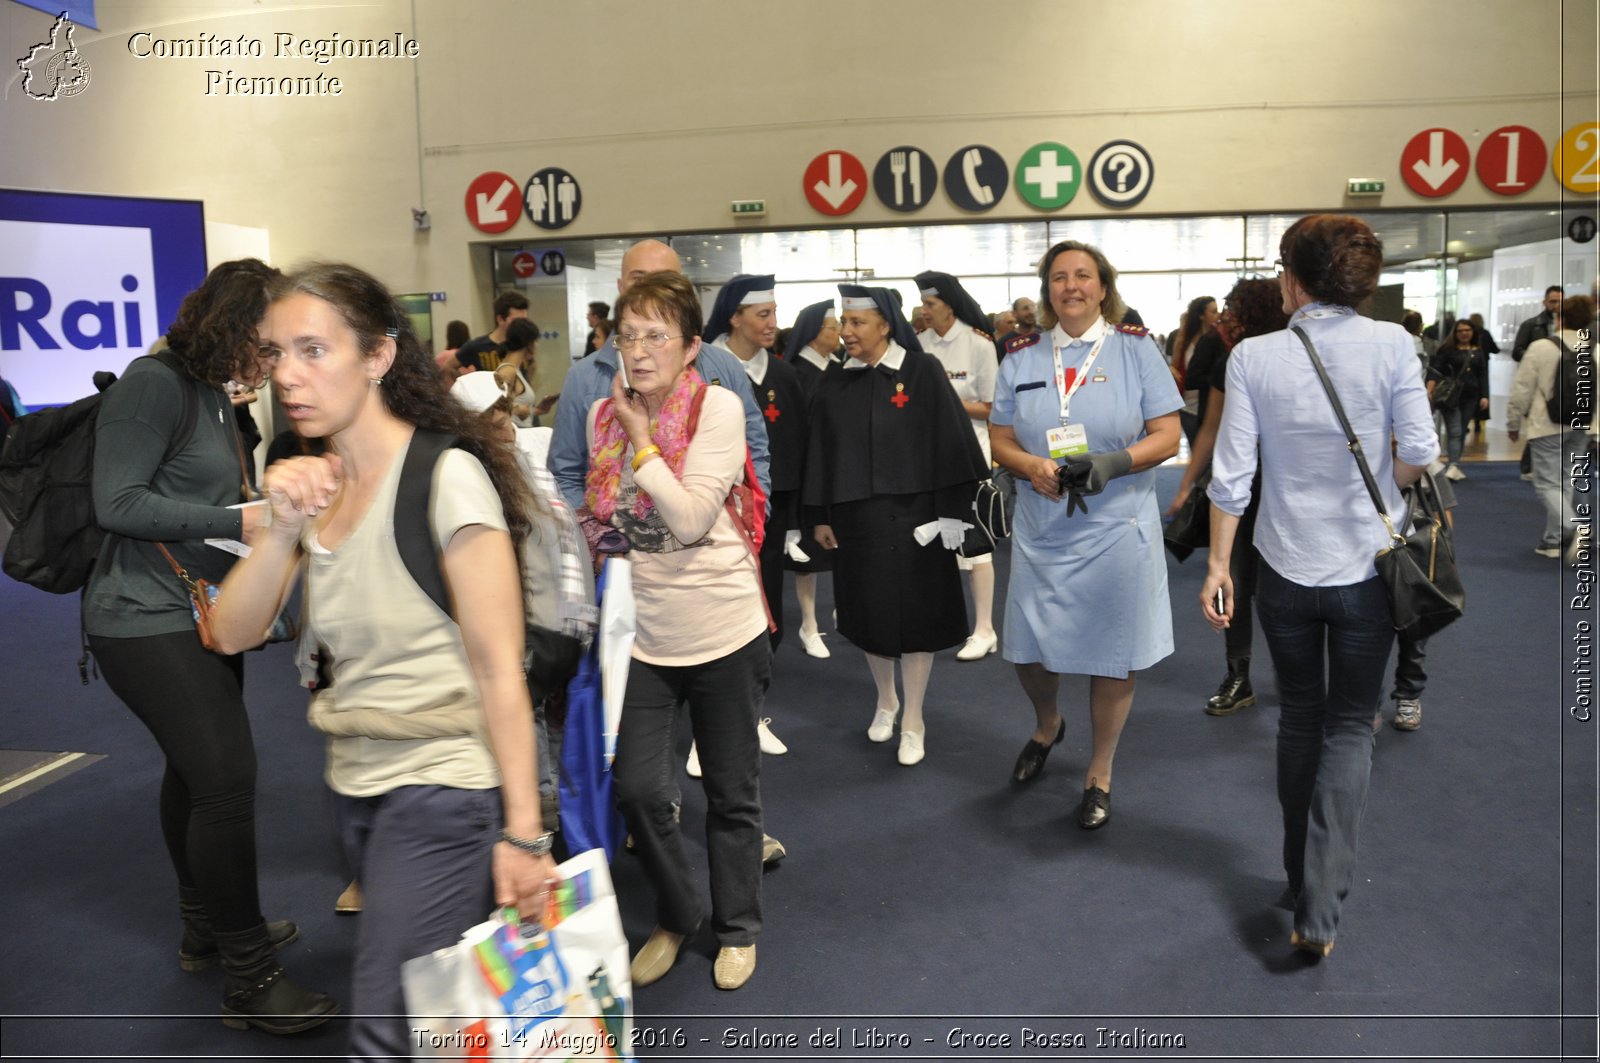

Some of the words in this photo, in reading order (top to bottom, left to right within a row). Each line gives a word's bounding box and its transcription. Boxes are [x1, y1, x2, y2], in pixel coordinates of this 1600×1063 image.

[1496, 132, 1526, 187] 1
[1571, 128, 1600, 184] 2
[0, 274, 143, 350] Rai
